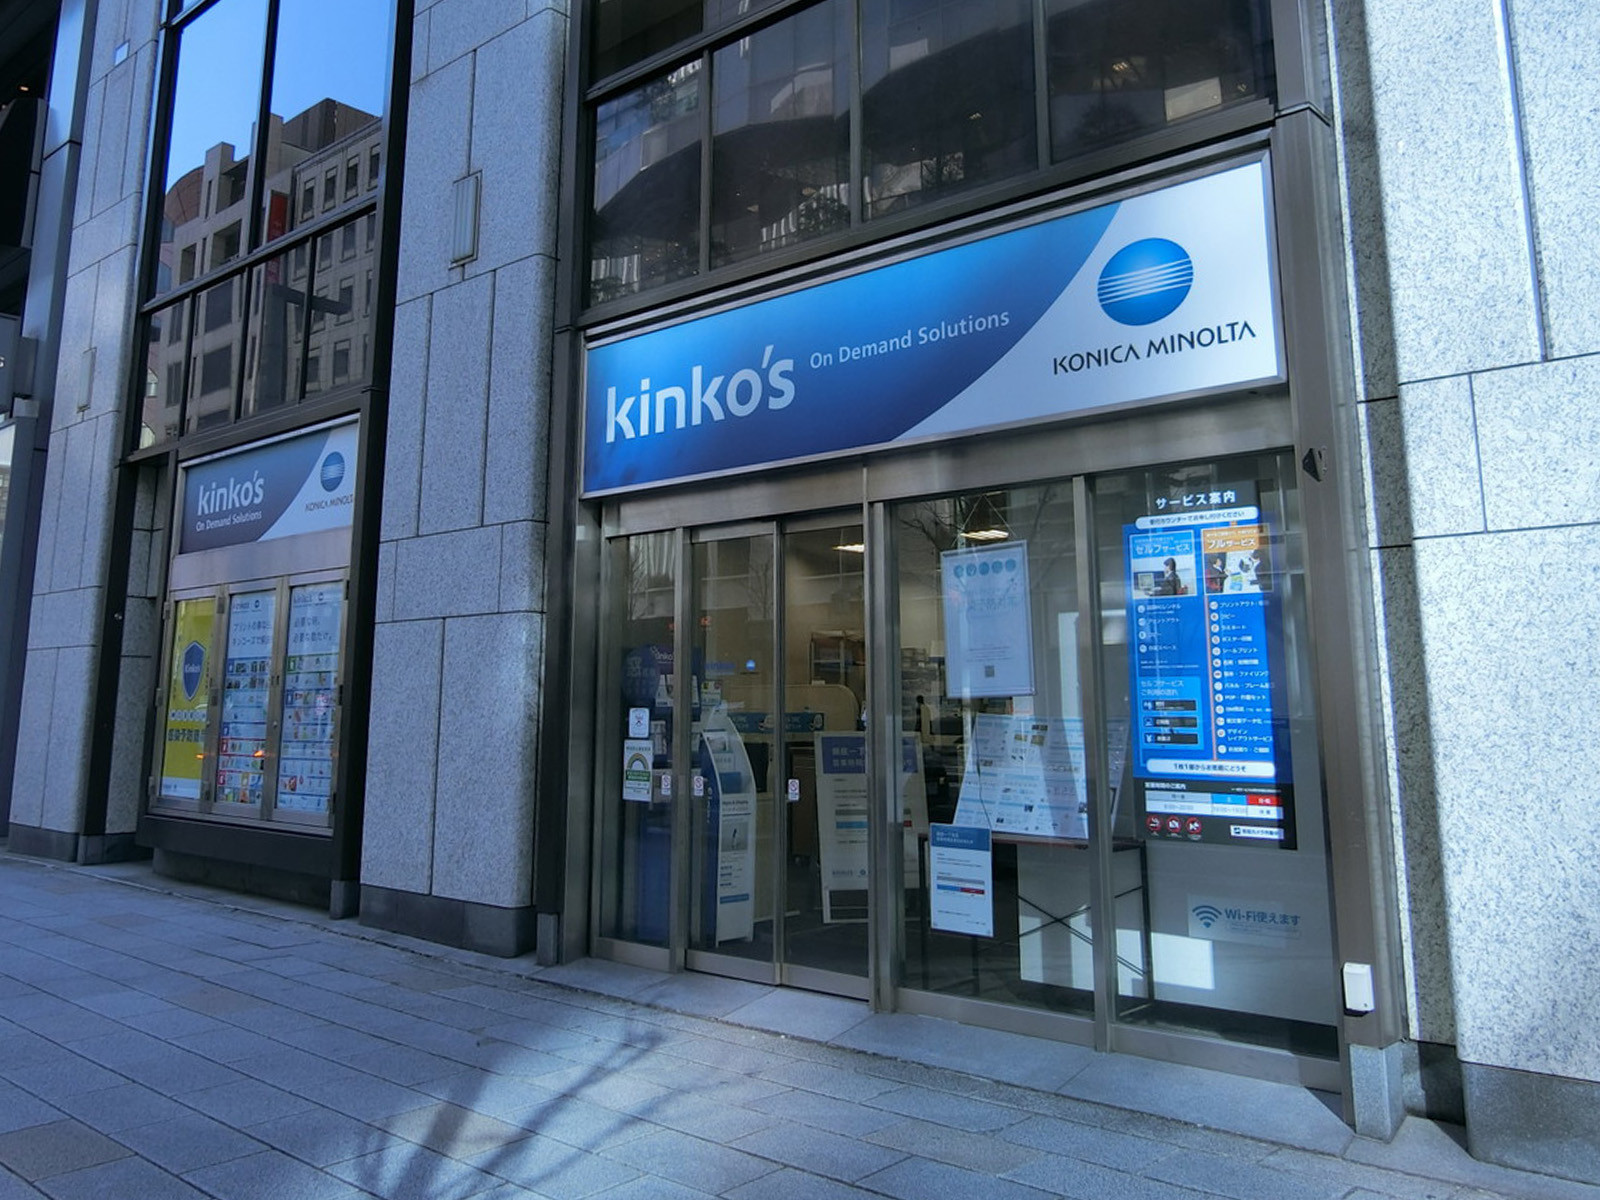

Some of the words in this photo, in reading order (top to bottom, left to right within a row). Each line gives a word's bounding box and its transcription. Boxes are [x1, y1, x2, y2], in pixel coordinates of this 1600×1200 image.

[810, 350, 833, 369] On
[839, 330, 912, 363] Demand
[918, 311, 1010, 345] Solutions
[1053, 343, 1140, 375] KONICA
[1146, 320, 1256, 358] MINOLTA
[606, 345, 795, 443] kinko's
[197, 470, 264, 516] kinko's
[1155, 490, 1236, 510] サービス案内
[195, 520, 204, 532] On
[206, 515, 231, 531] Demand
[232, 510, 263, 524] Solutions
[1135, 543, 1191, 556] セルフサービス
[1207, 538, 1257, 550] フルサービス
[1225, 908, 1300, 926] Wi-Fi使えます
